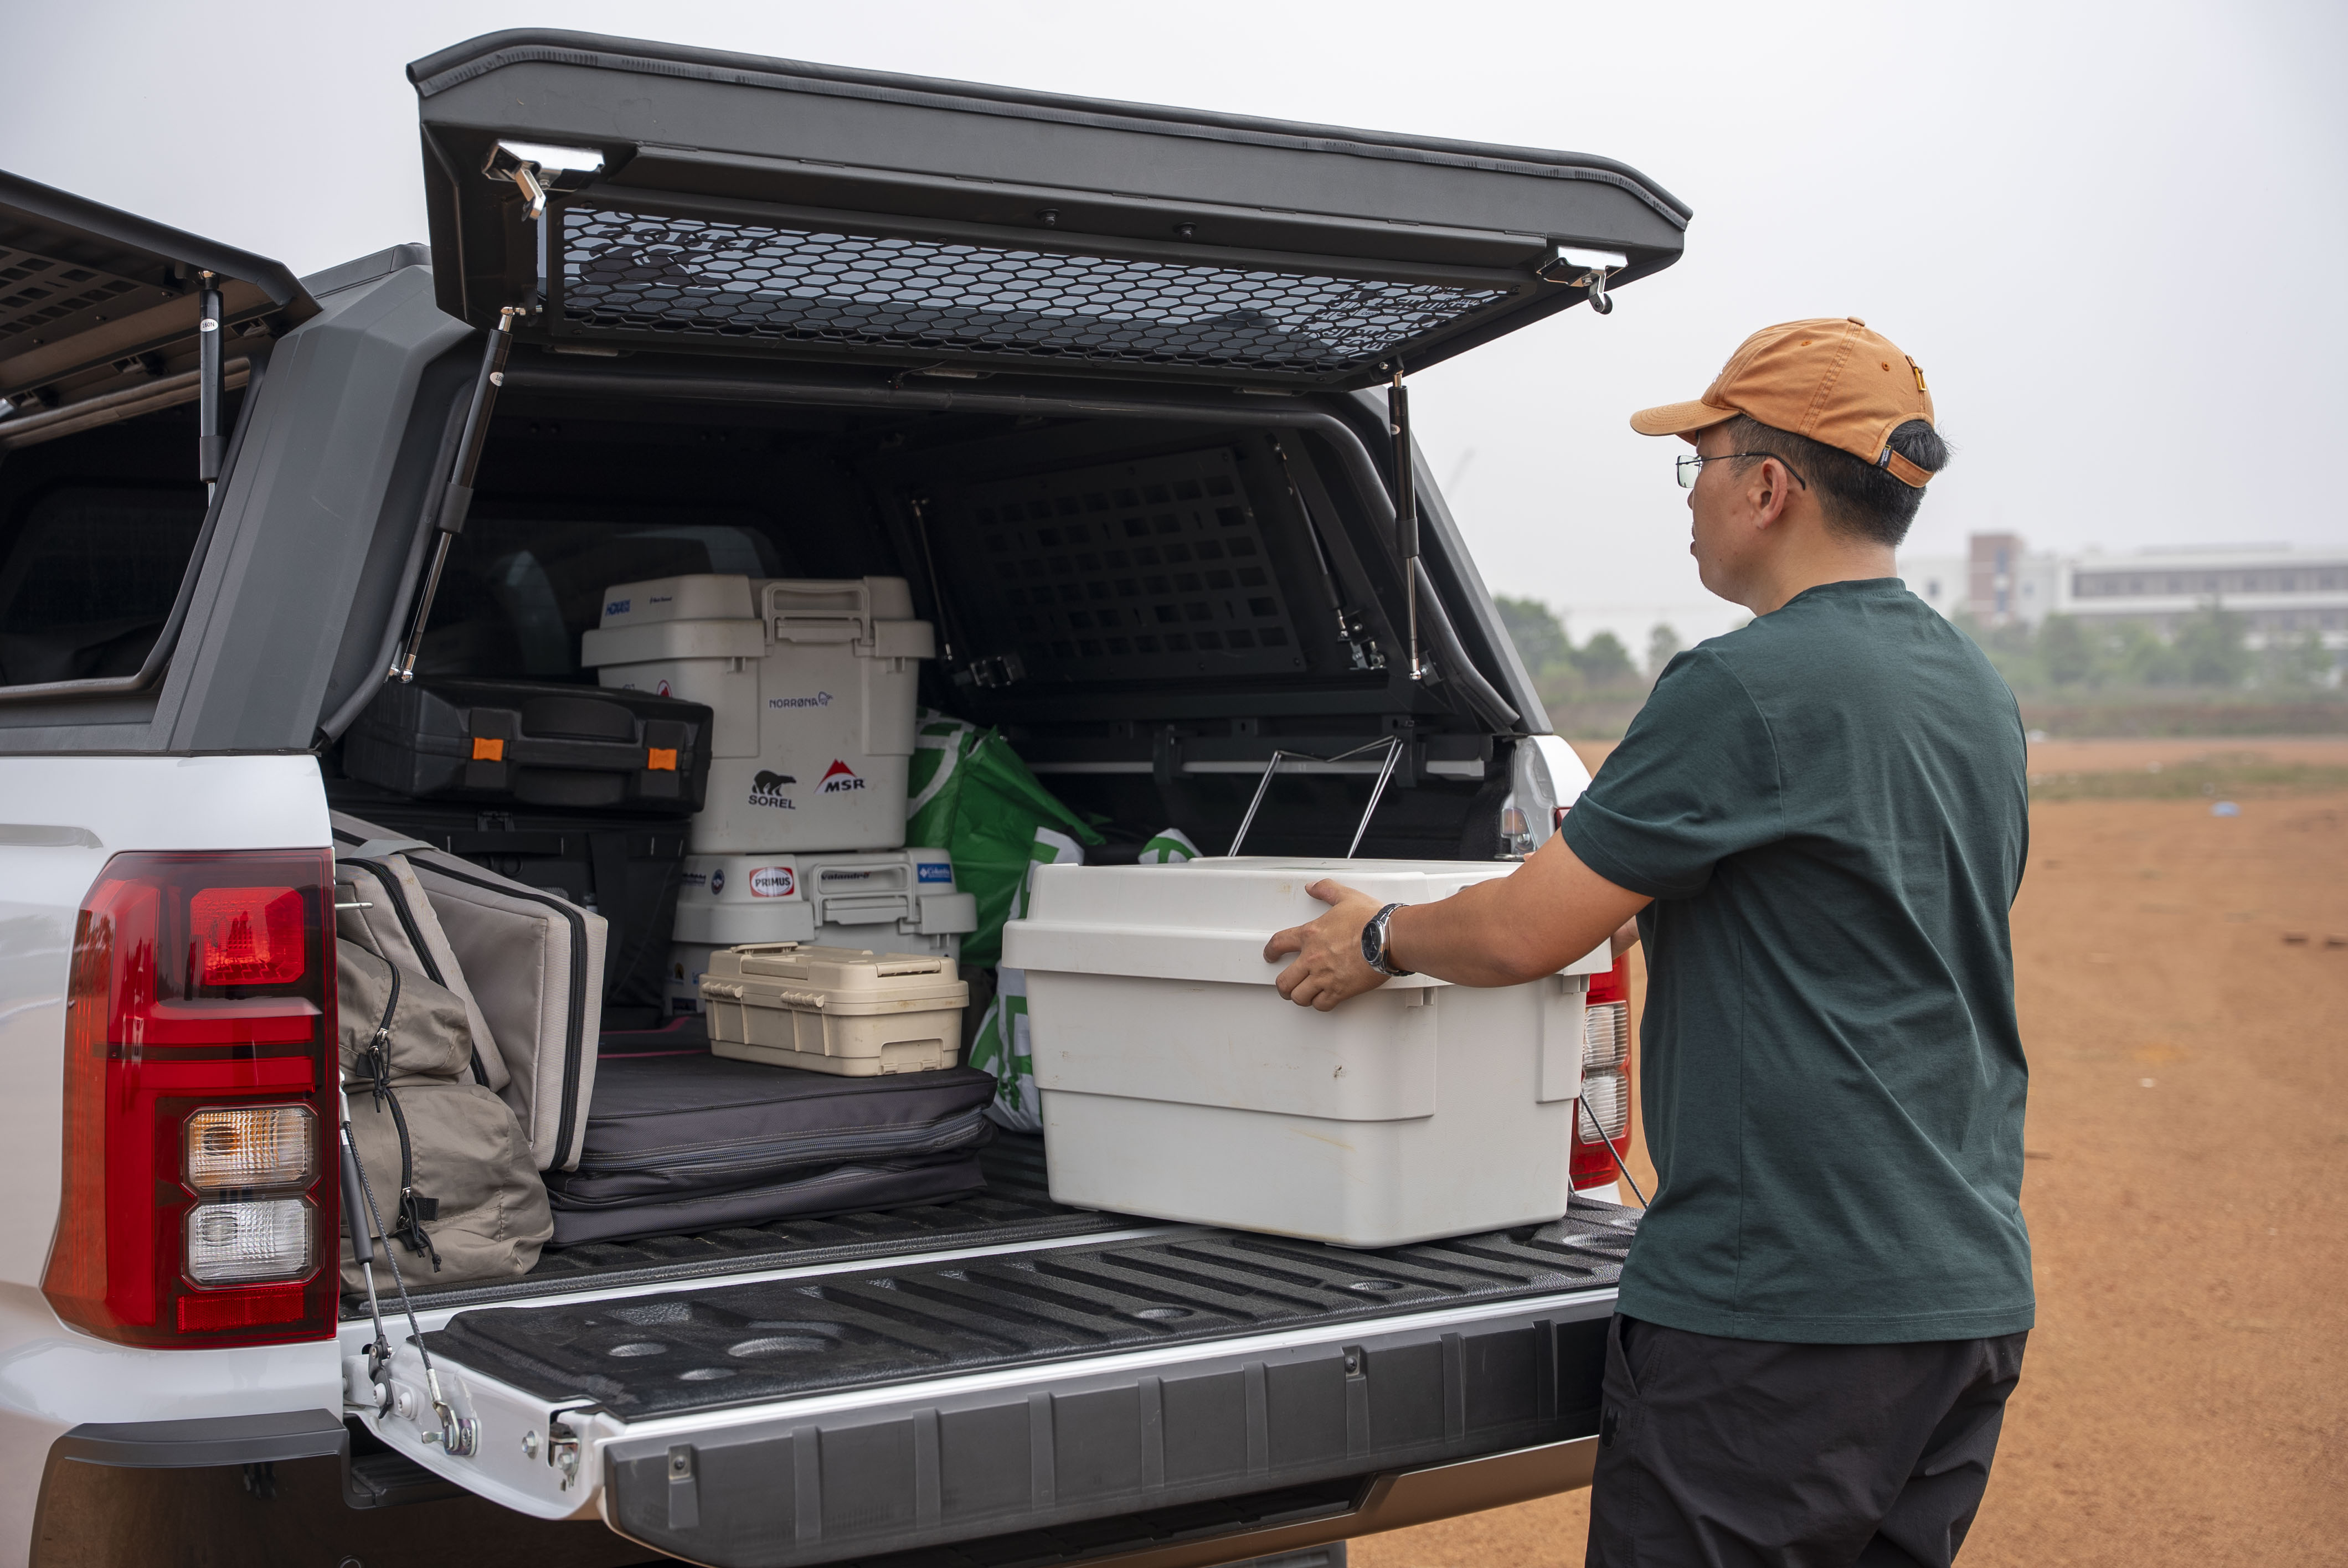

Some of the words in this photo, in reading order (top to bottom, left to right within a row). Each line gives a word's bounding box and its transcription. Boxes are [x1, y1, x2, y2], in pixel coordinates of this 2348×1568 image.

[825, 778, 866, 793] MSR
[748, 795, 796, 810] SOREL
[755, 876, 791, 888] PRIMUS
